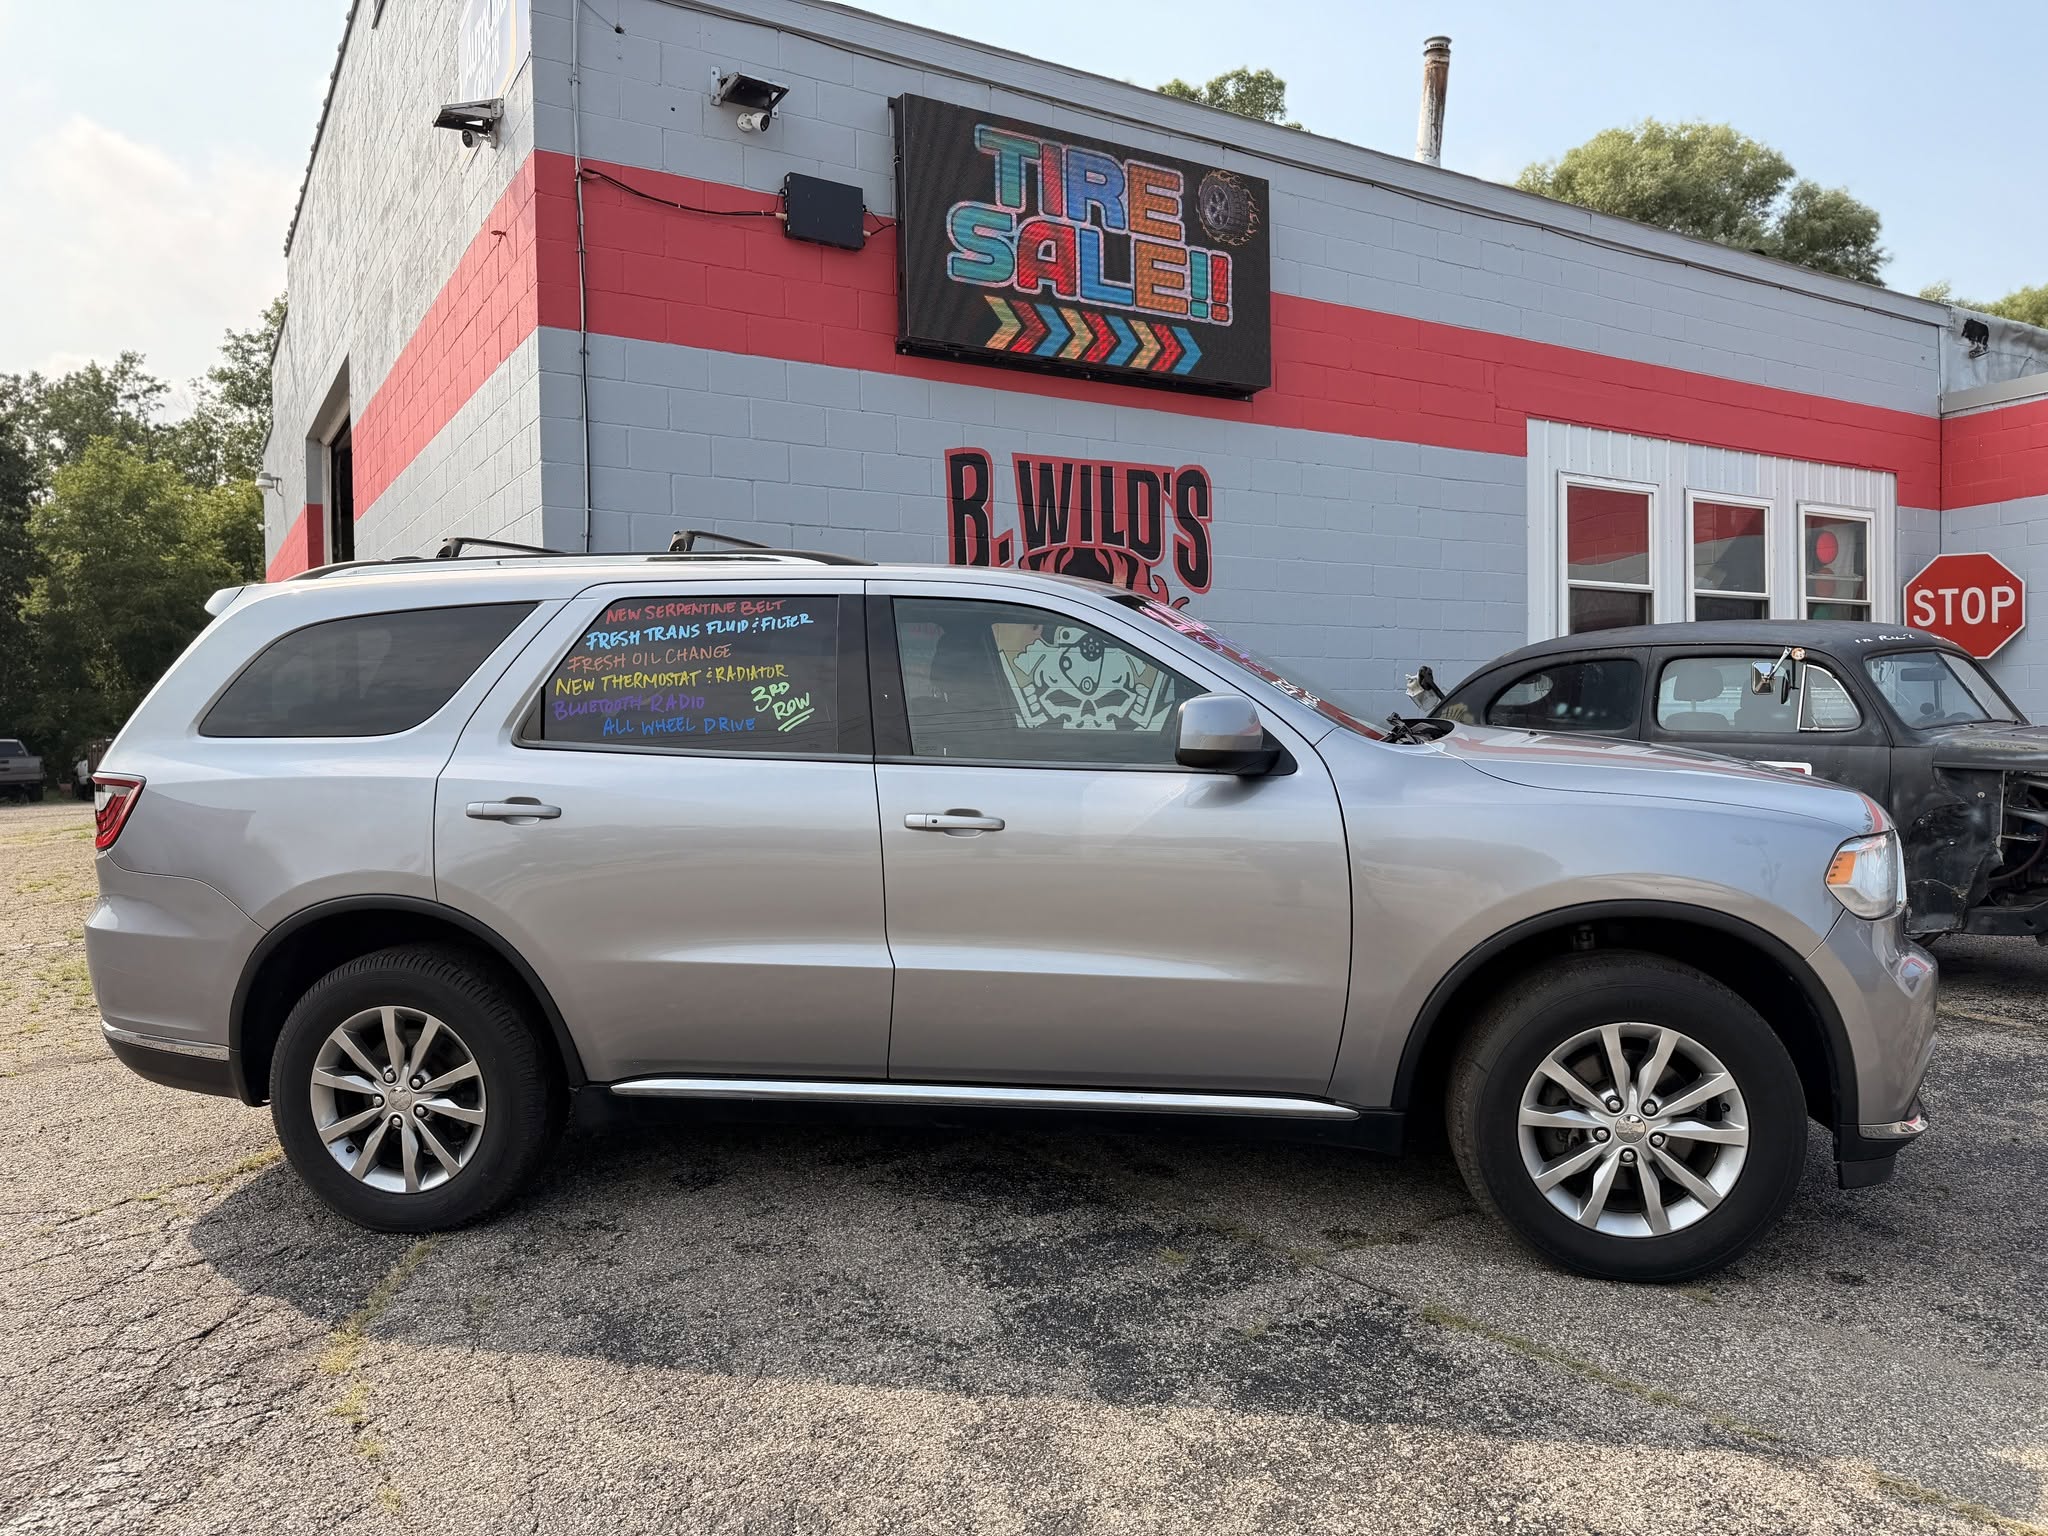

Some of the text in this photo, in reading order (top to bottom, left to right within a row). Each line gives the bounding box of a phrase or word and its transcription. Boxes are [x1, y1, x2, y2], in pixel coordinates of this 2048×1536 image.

[974, 123, 1185, 243] TIRE
[946, 200, 1234, 327] SALE!!
[1011, 452, 1212, 594] WILD'S
[606, 600, 787, 624] NEW SERPENTINE BELT
[1913, 586, 2016, 627] STOP
[586, 629, 641, 650] FRESH
[644, 619, 700, 641] TRANS
[706, 618, 749, 638] FLUID
[761, 613, 814, 630] FILTER
[567, 644, 733, 673] FRESH OIL CHANGE
[555, 677, 596, 696] NEW
[601, 670, 702, 692] THERMOSTAT
[715, 664, 789, 684] RADIATOR
[552, 695, 705, 721] BLUETOOTH RADIO
[751, 681, 790, 713] 3RD
[773, 692, 811, 721] ROW
[602, 715, 756, 737] ALL WHEEL DRIVE
